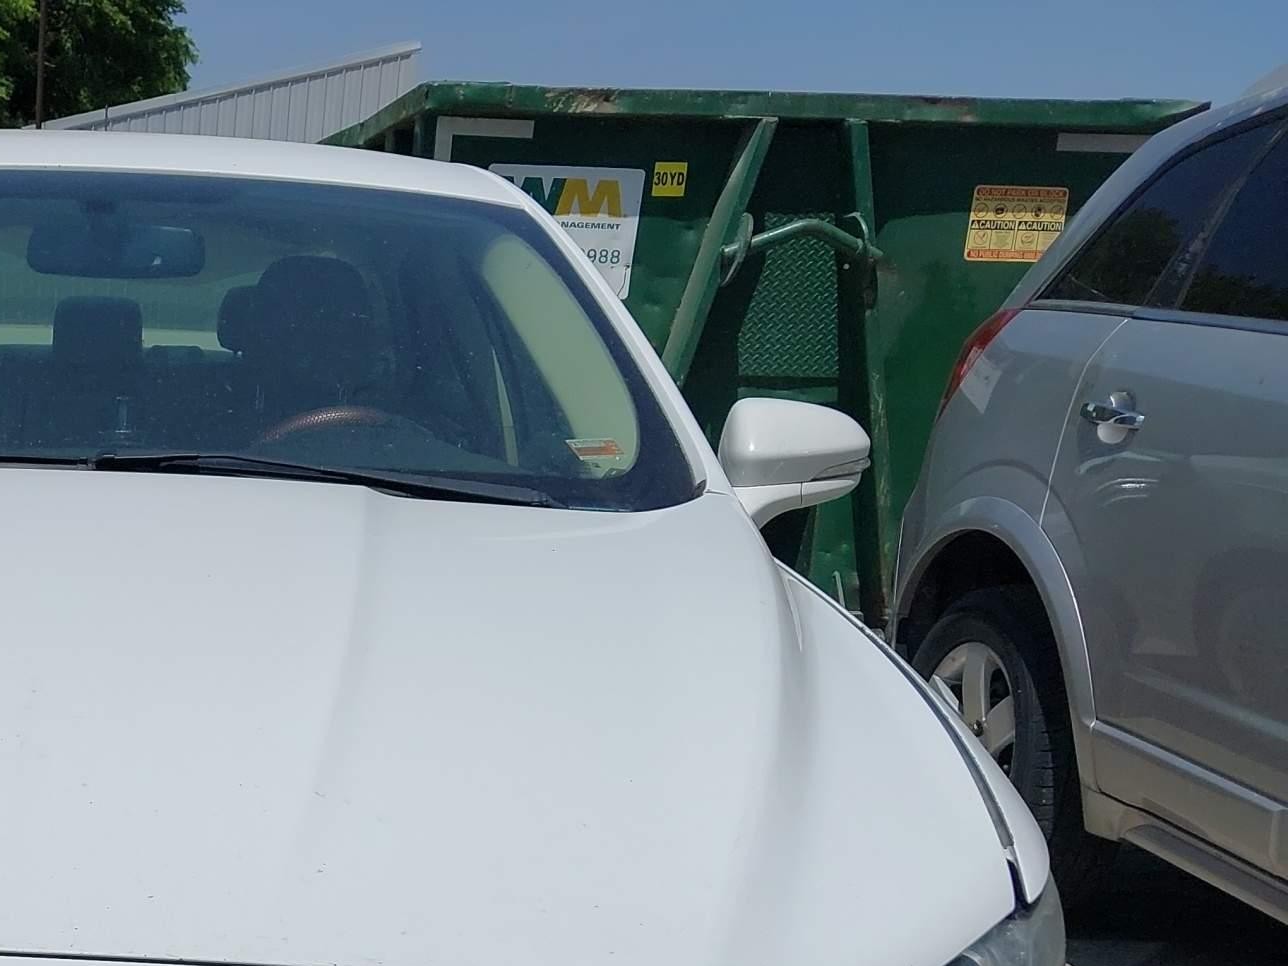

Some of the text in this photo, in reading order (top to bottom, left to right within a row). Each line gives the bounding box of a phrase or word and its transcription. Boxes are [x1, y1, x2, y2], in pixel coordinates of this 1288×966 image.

[654, 172, 685, 186] 30YD
[502, 176, 621, 217] WM
[557, 221, 621, 230] NAGEMENT
[979, 221, 1015, 230] CAUTION
[1026, 221, 1062, 231] CAUTION
[580, 248, 621, 264] 988
